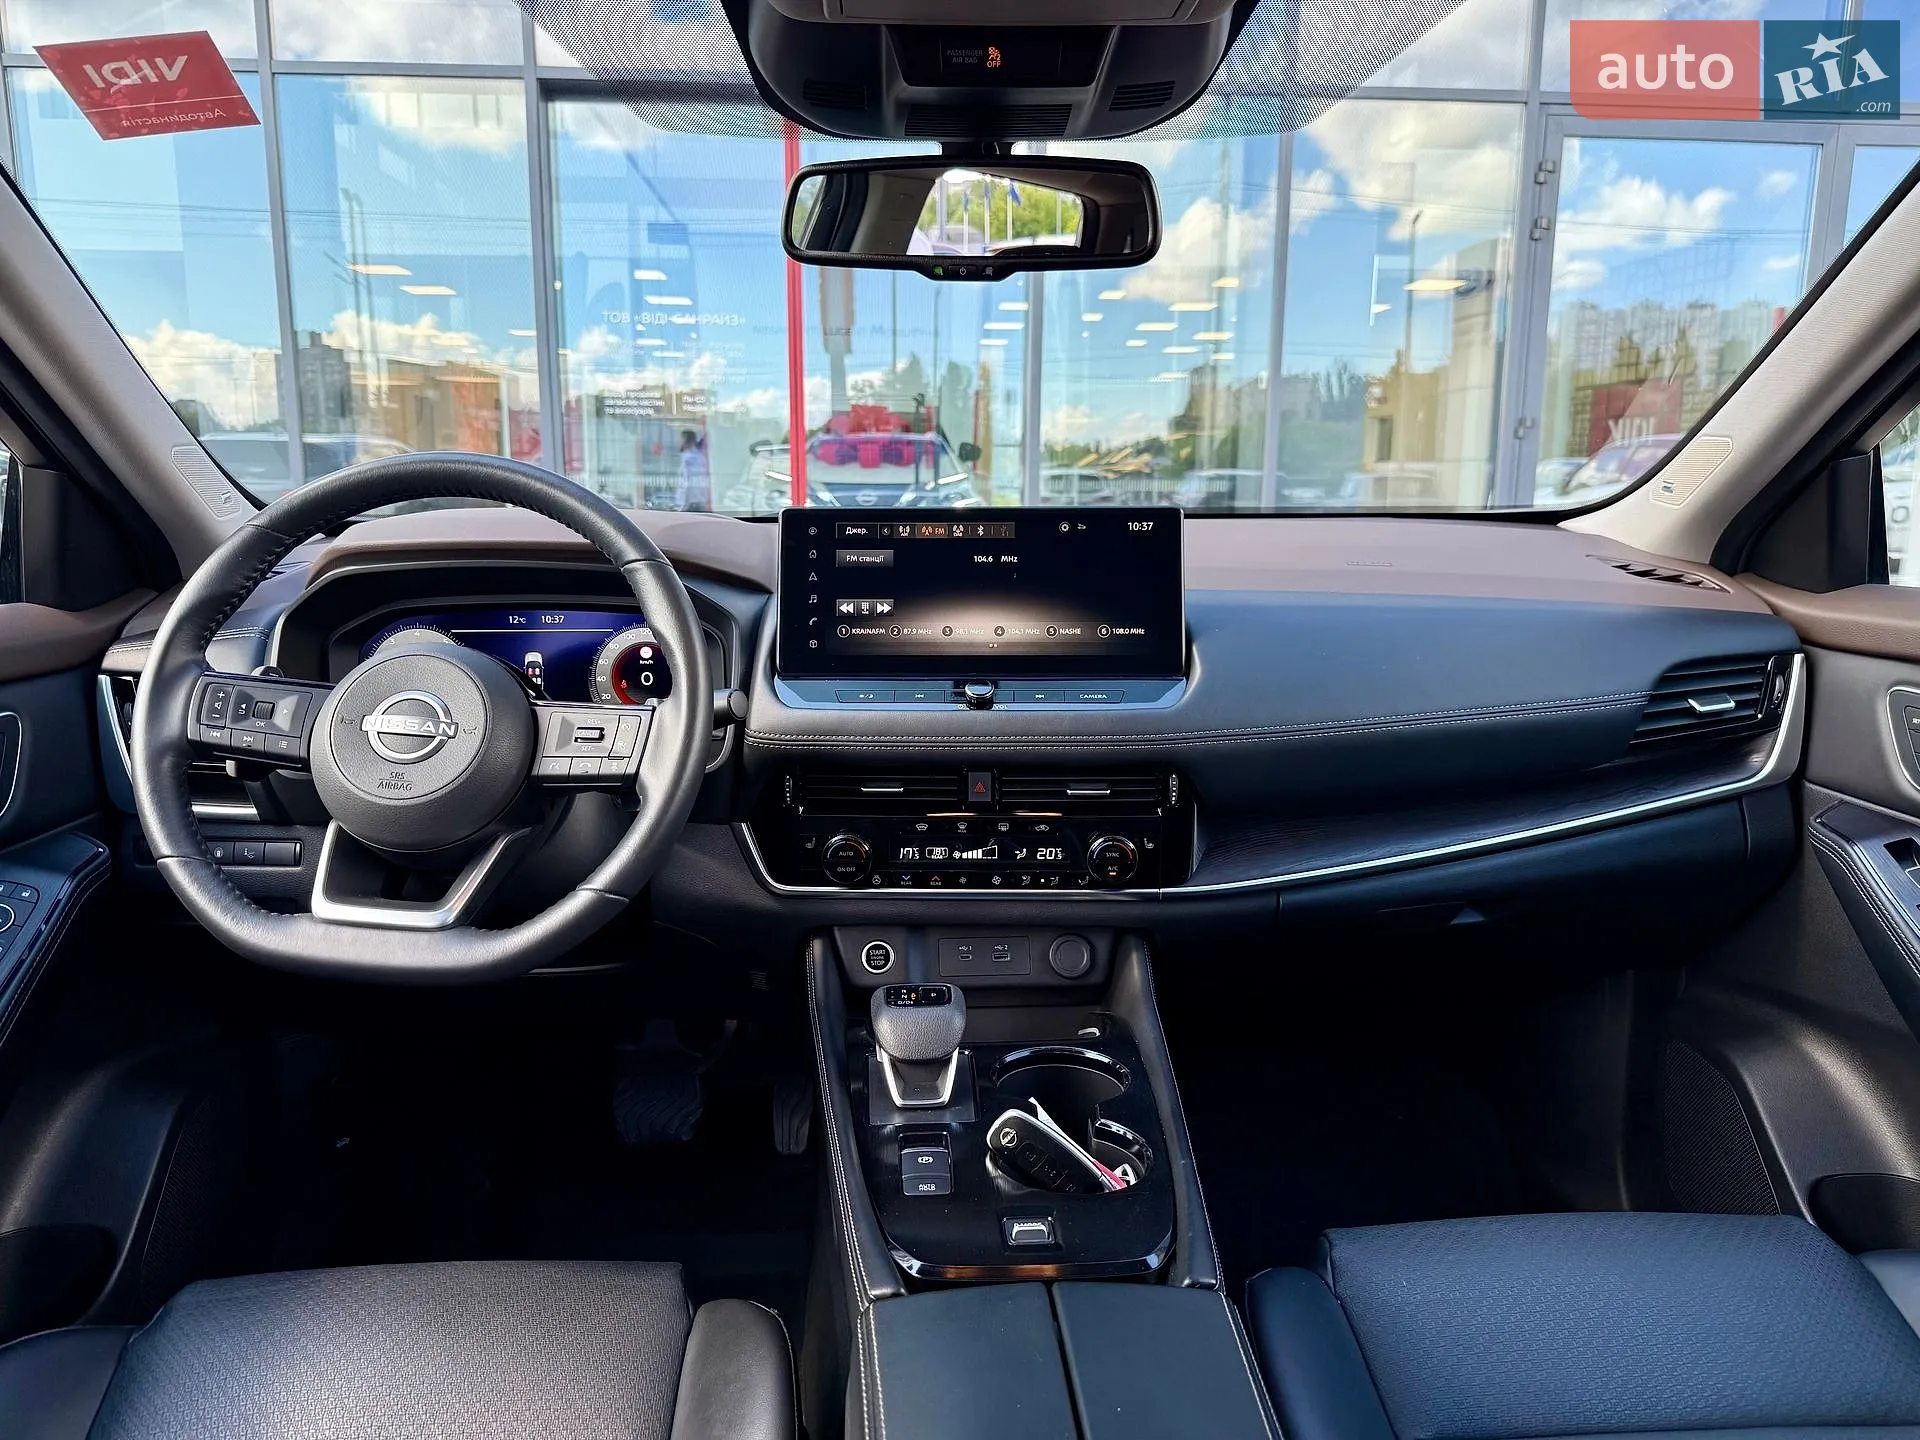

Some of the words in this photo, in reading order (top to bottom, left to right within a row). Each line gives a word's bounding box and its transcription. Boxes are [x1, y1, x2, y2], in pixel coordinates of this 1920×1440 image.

[601, 312, 631, 324] ТОВ
[1128, 522, 1154, 530] 10:37
[846, 527, 868, 535] Джер.
[859, 555, 884, 563] станції
[541, 615, 564, 623] 10:37
[364, 716, 456, 736] NISSAN
[390, 772, 405, 780] SRS
[377, 781, 413, 791] AIRBAG
